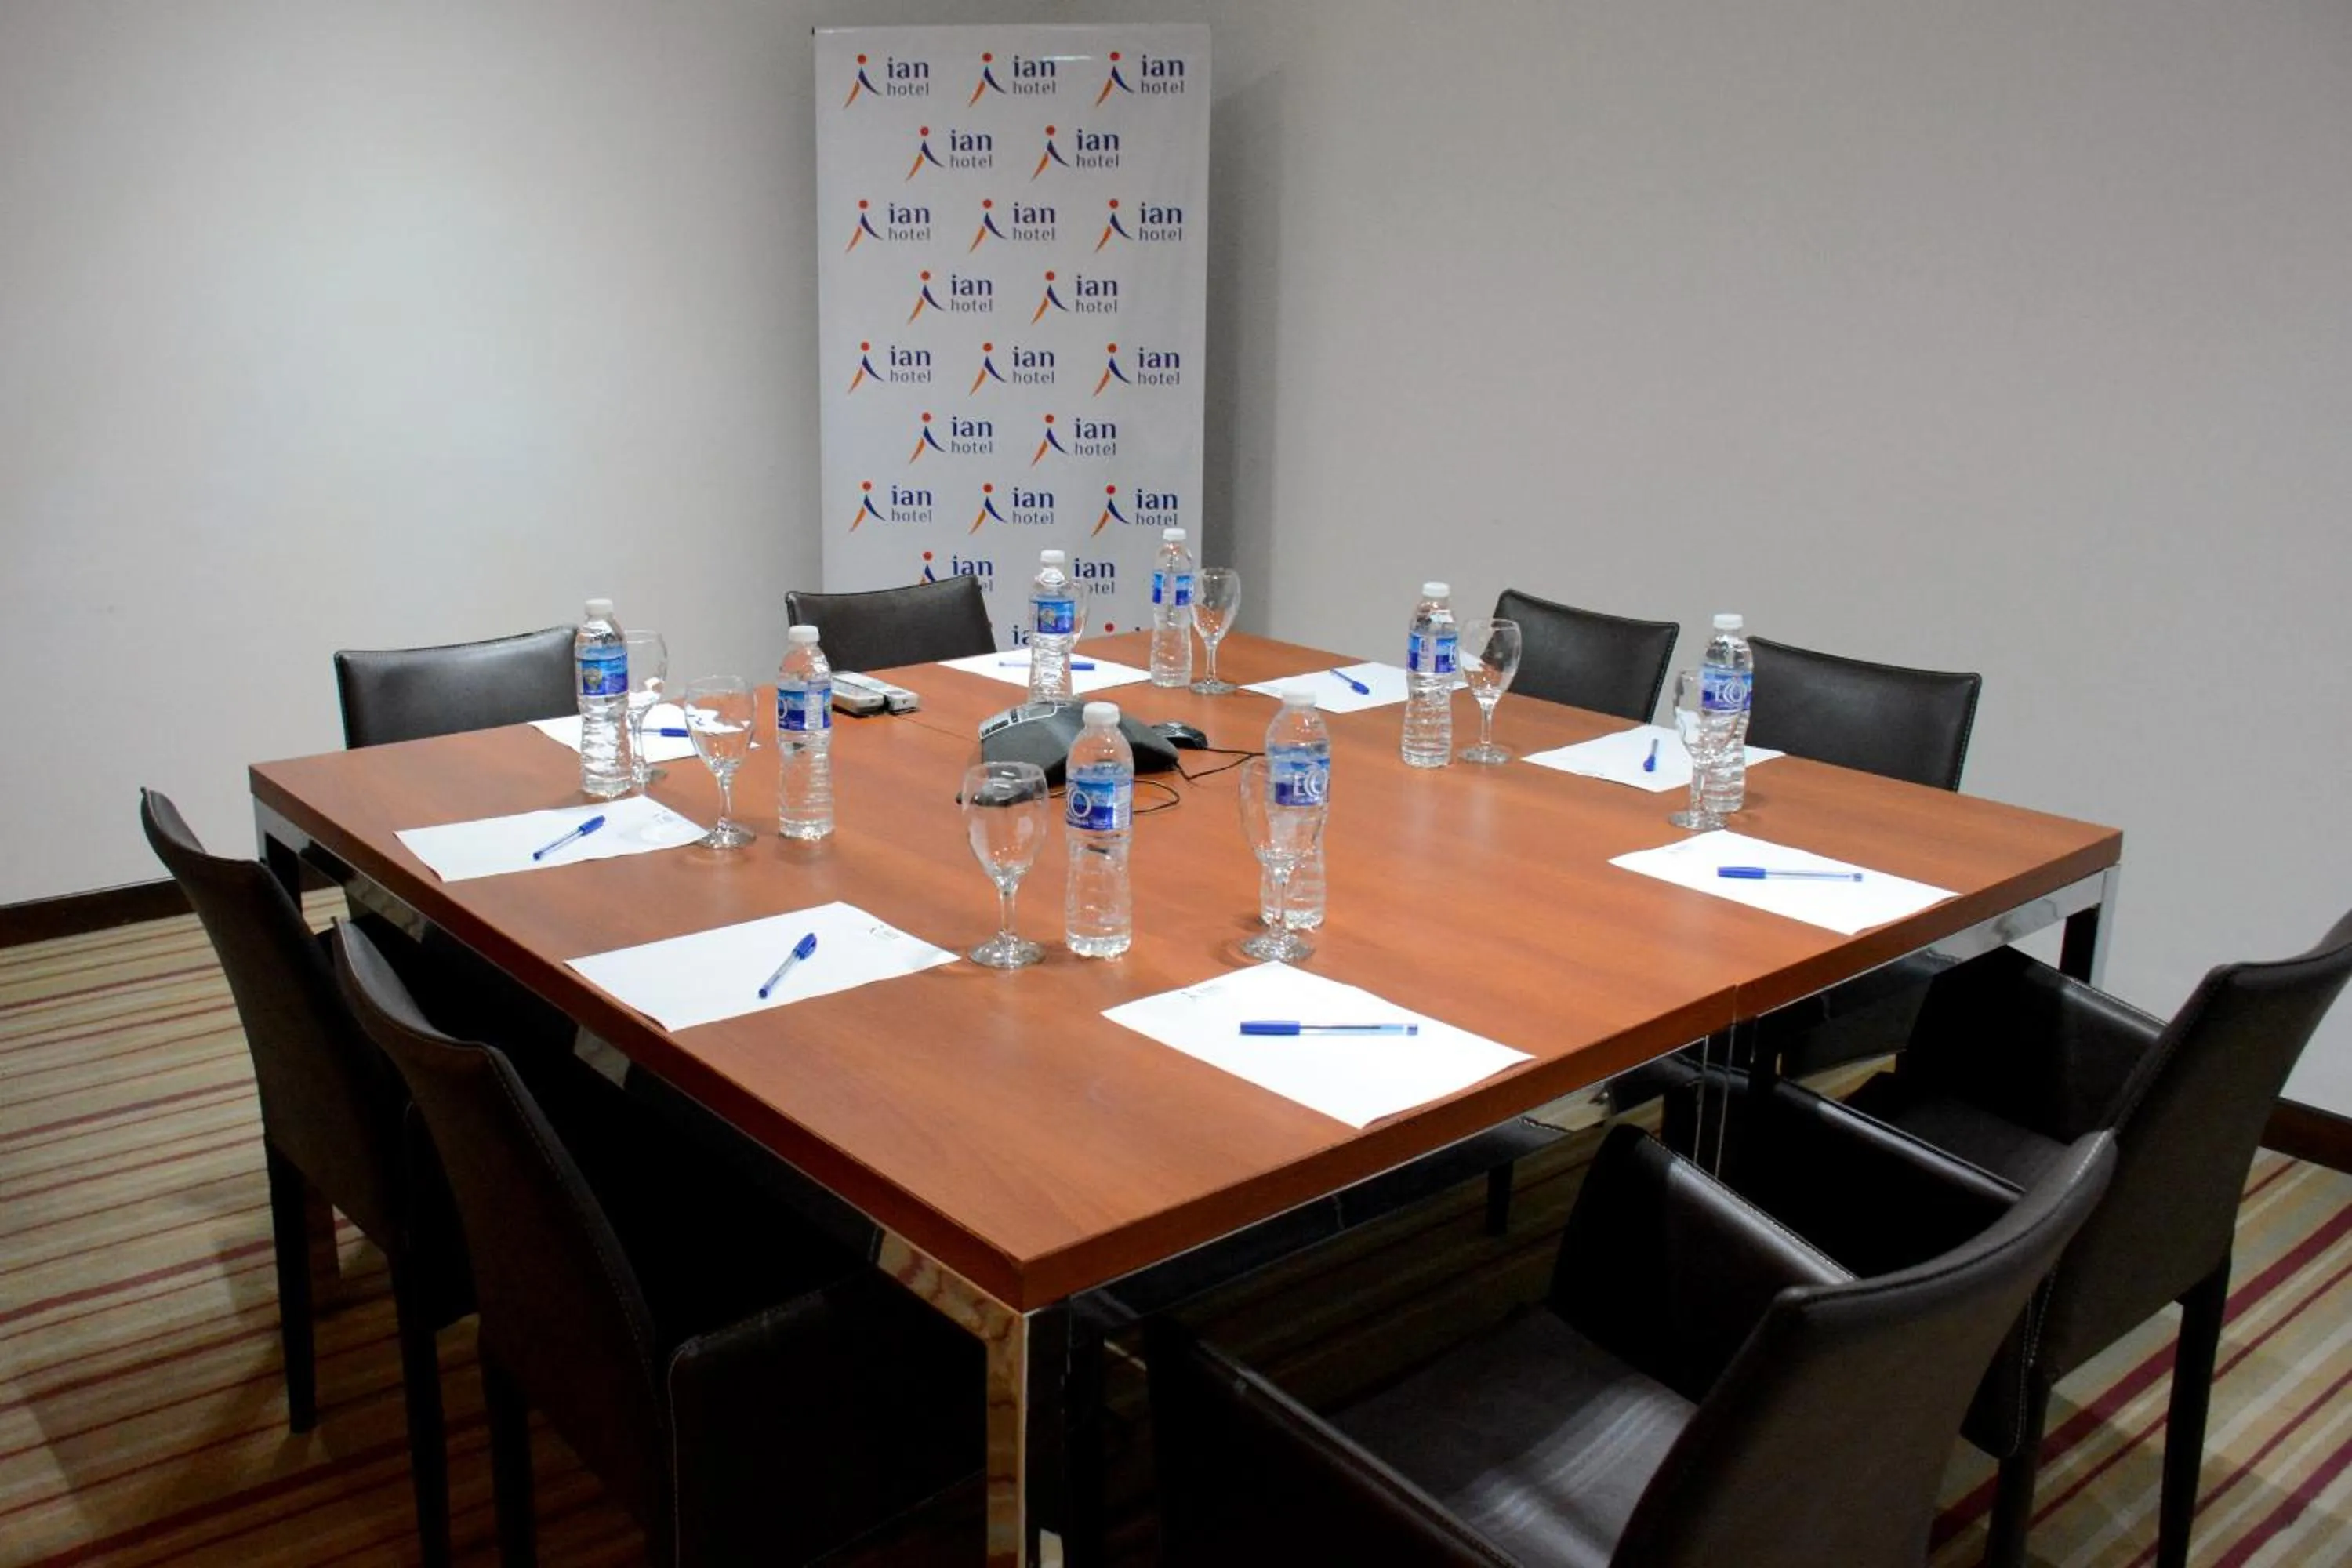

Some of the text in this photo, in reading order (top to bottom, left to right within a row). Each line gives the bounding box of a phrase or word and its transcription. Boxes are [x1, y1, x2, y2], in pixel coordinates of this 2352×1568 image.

[887, 56, 929, 79] ian
[1013, 54, 1056, 78] ian
[1141, 54, 1184, 77] ian
[887, 81, 929, 96] hotel
[1013, 79, 1056, 95] hotel
[1141, 79, 1184, 95] hotel
[949, 129, 993, 151] ian
[1076, 128, 1120, 151] ian
[949, 154, 993, 169] hotel
[1076, 153, 1120, 169] hotel
[888, 202, 931, 225] ian
[1013, 201, 1056, 224] ian
[1139, 201, 1183, 224] ian
[888, 227, 931, 241] hotel
[1013, 226, 1056, 241] hotel
[1138, 226, 1182, 241] hotel
[950, 274, 993, 296] ian
[1076, 274, 1118, 297] ian
[950, 298, 993, 314] hotel
[1075, 299, 1118, 314] hotel
[890, 345, 931, 367] ian
[1013, 346, 1055, 368] ian
[1138, 347, 1180, 369] ian
[890, 368, 931, 383] hotel
[1013, 369, 1055, 384] hotel
[1138, 371, 1180, 386] hotel
[950, 416, 993, 438] ian
[1074, 417, 1116, 440] ian
[950, 440, 993, 454] hotel
[1074, 441, 1116, 456] hotel
[891, 485, 932, 506] ian
[1012, 486, 1054, 508] ian
[1134, 488, 1178, 510] ian
[891, 508, 932, 523] hotel
[1012, 510, 1054, 525] hotel
[1134, 512, 1178, 527] hotel
[951, 554, 993, 576] ian
[1073, 557, 1115, 579] ian
